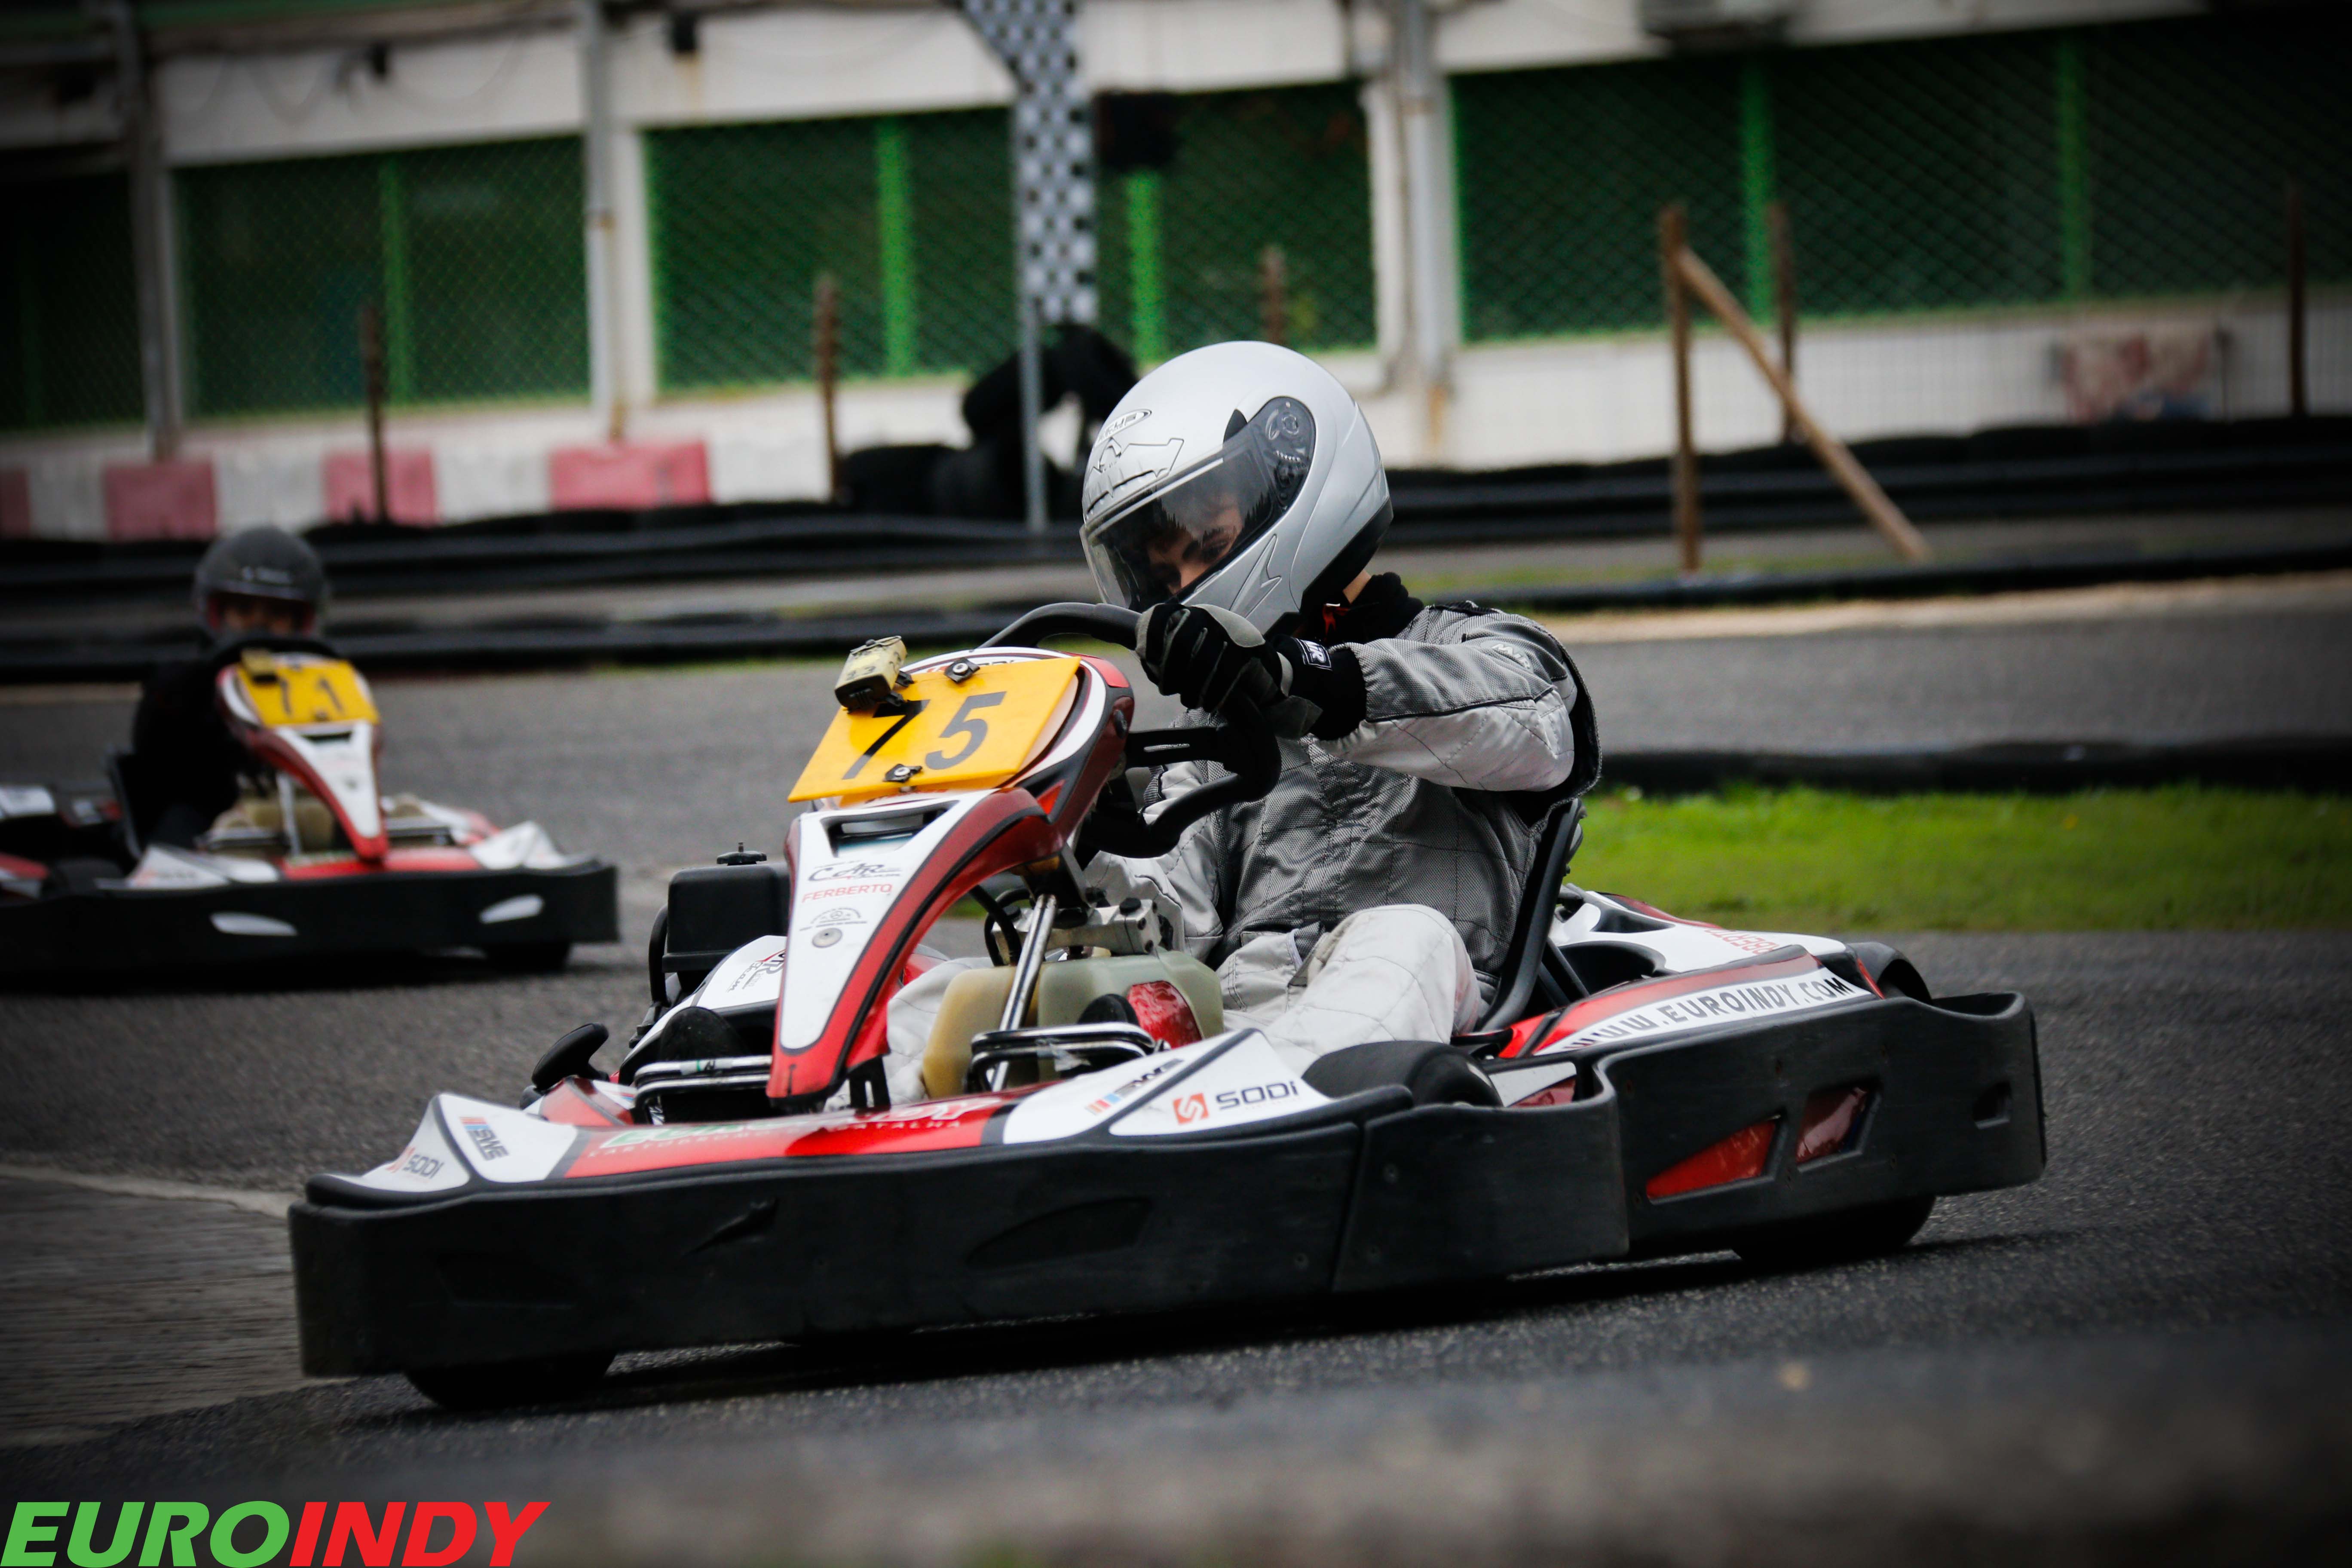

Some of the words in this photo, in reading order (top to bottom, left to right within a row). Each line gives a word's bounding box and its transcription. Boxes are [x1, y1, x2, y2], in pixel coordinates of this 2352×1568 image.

[842, 690, 1007, 780] 75
[801, 883, 893, 903] FERBERTO
[1216, 1081, 1298, 1110] SODI
[403, 1154, 445, 1179] SODI
